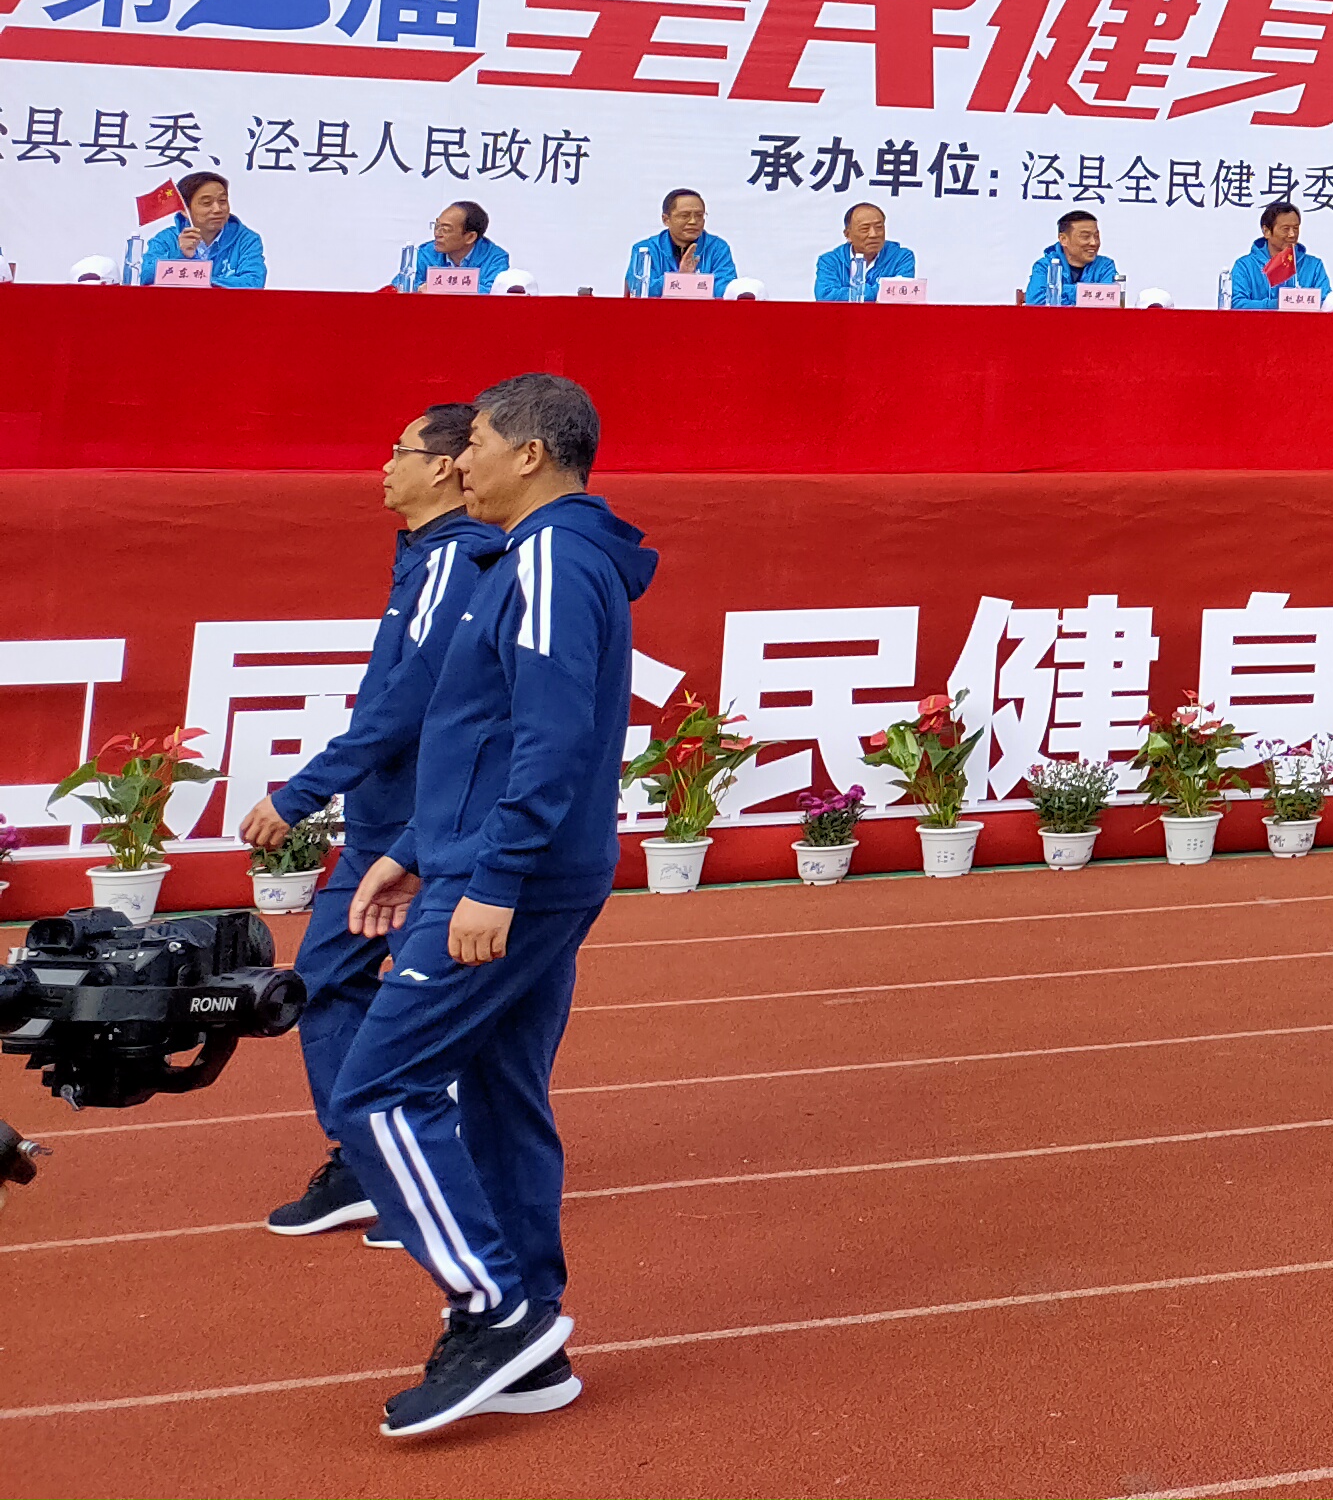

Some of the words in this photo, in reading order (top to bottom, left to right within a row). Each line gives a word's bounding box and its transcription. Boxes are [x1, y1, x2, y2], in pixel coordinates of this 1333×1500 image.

[0, 106, 592, 186] 县县委、泾县人民政府
[190, 997, 238, 1012] RONIN
